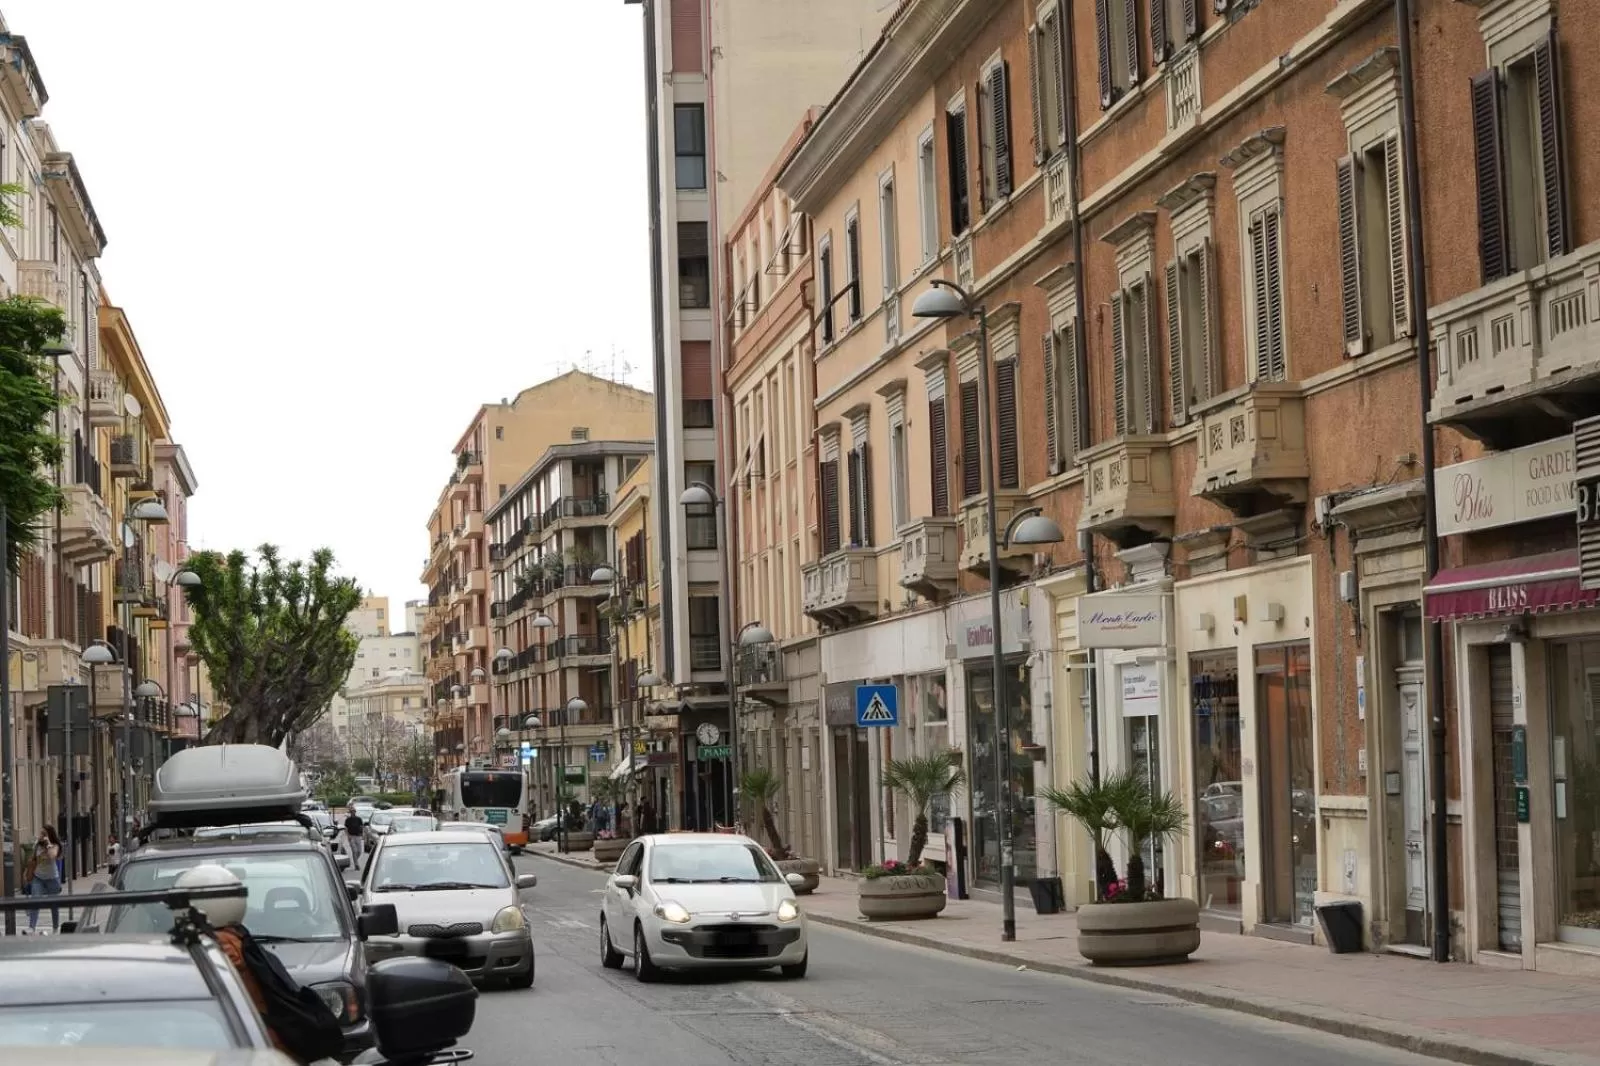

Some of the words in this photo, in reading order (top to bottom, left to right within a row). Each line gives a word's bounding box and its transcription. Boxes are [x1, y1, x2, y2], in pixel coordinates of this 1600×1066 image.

[1453, 473, 1493, 523] Bliss
[1526, 485, 1552, 507] FOOD
[1489, 584, 1527, 609] BLISS
[1082, 609, 1123, 624] Monte
[1124, 608, 1158, 623] Carlo
